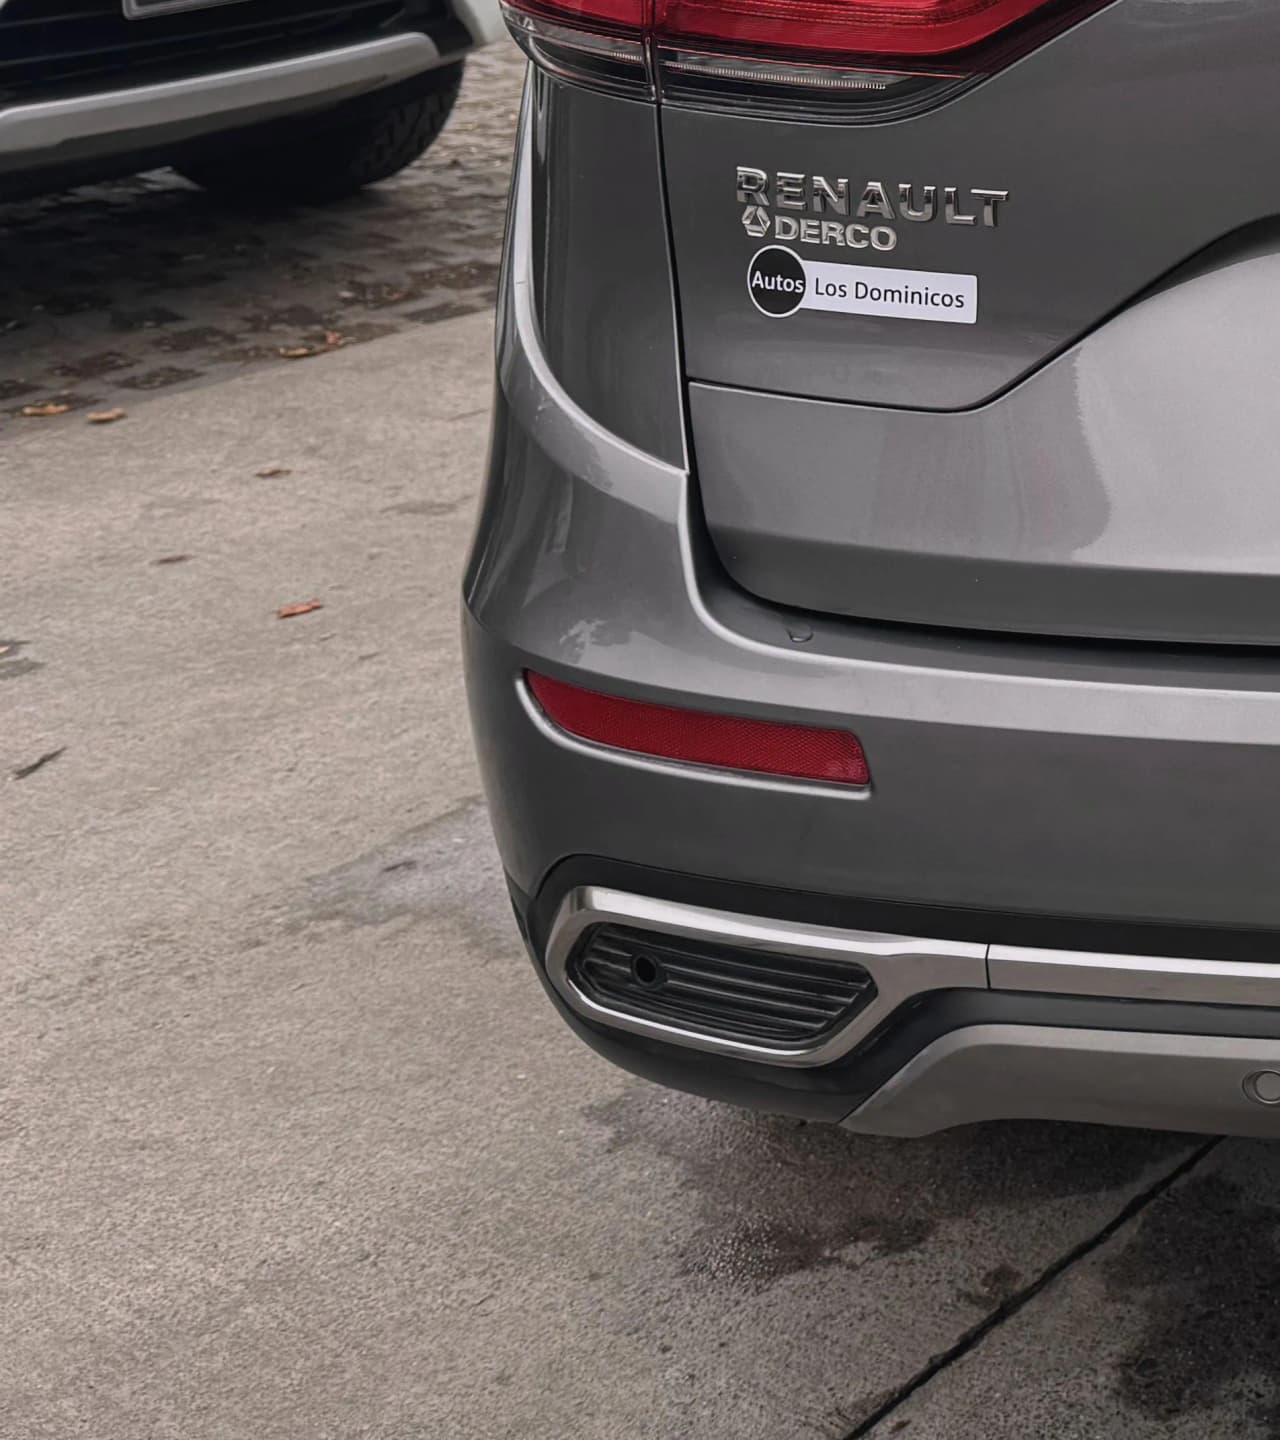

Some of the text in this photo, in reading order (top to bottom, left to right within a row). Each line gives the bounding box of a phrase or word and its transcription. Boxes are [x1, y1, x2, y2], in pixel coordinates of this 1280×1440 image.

[736, 166, 1009, 228] RENAULT
[774, 215, 898, 252] DERCO
[751, 270, 965, 309] Autos Los Dominicos
